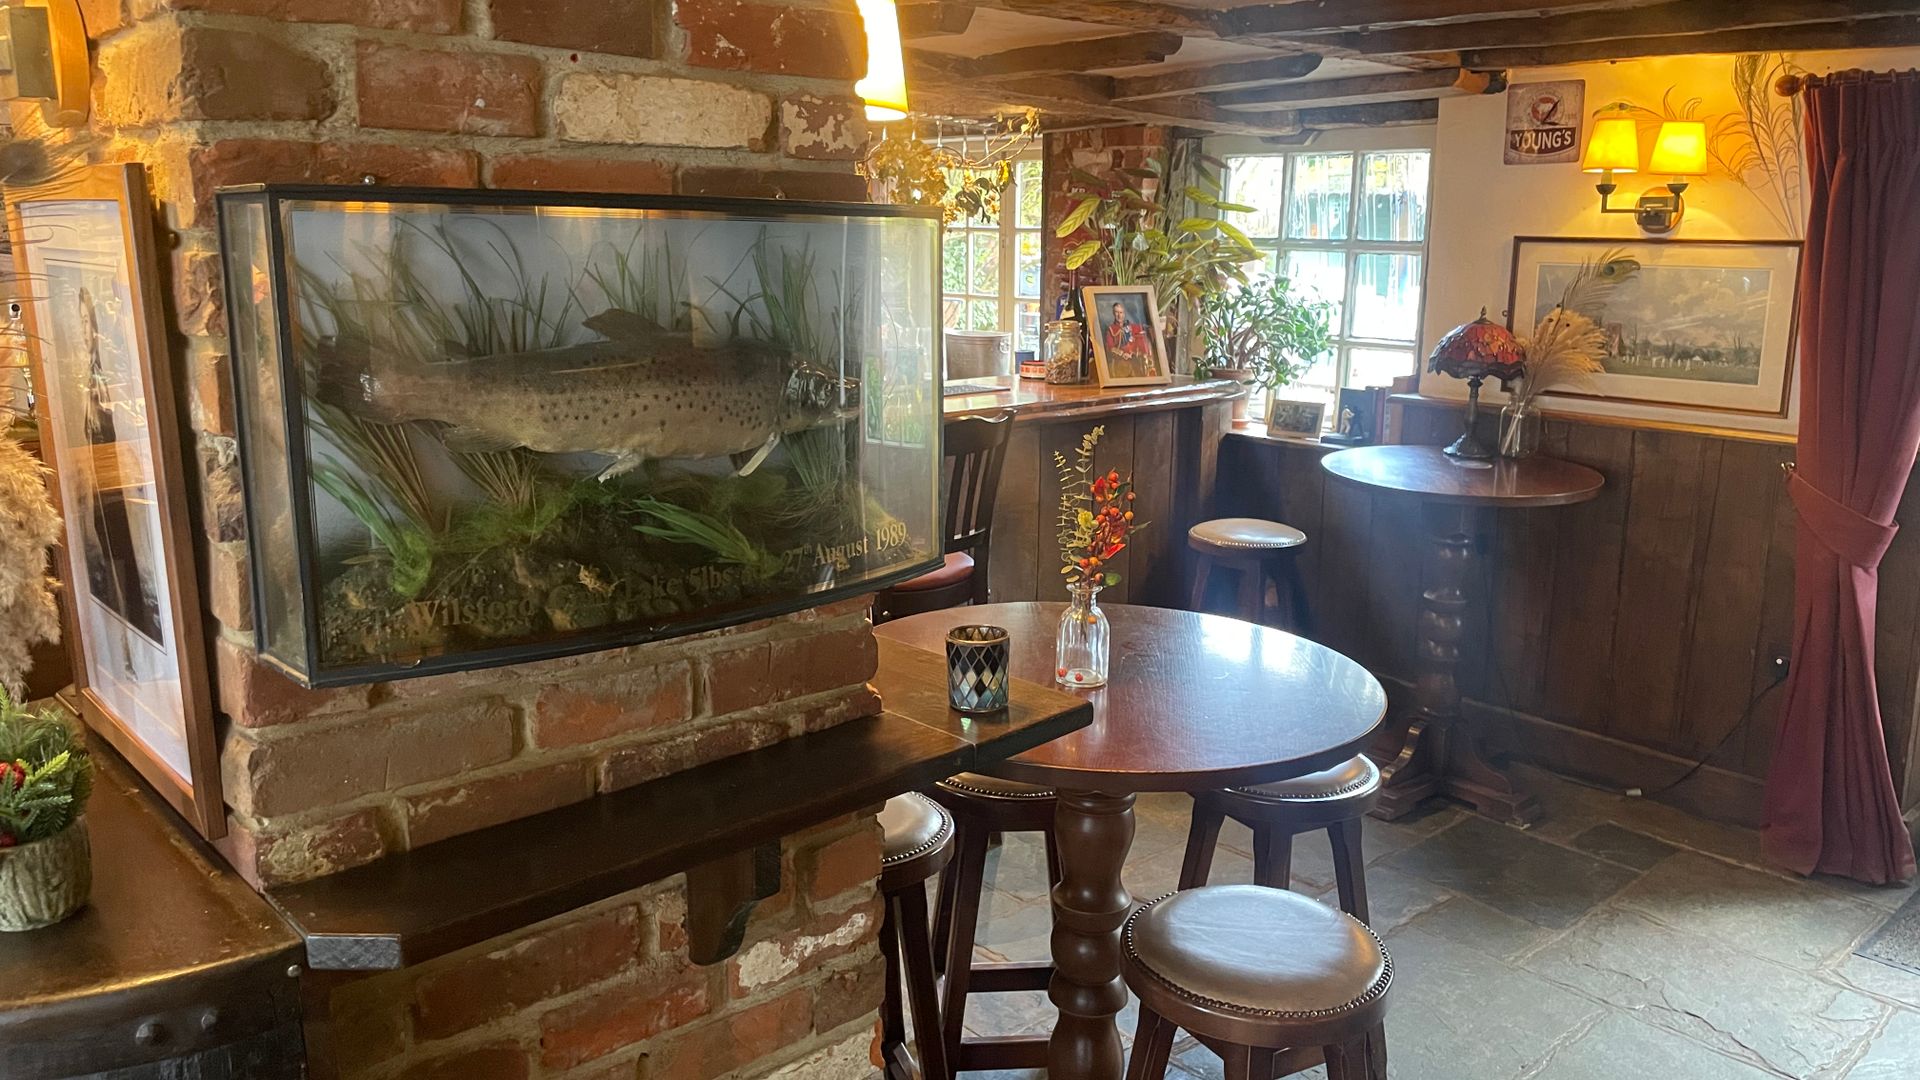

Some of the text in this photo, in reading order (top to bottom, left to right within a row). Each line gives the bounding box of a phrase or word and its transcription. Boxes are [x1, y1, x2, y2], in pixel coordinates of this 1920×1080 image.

[1515, 130, 1571, 149] YOUNG'S
[813, 536, 868, 570] August
[876, 522, 906, 551] 1989
